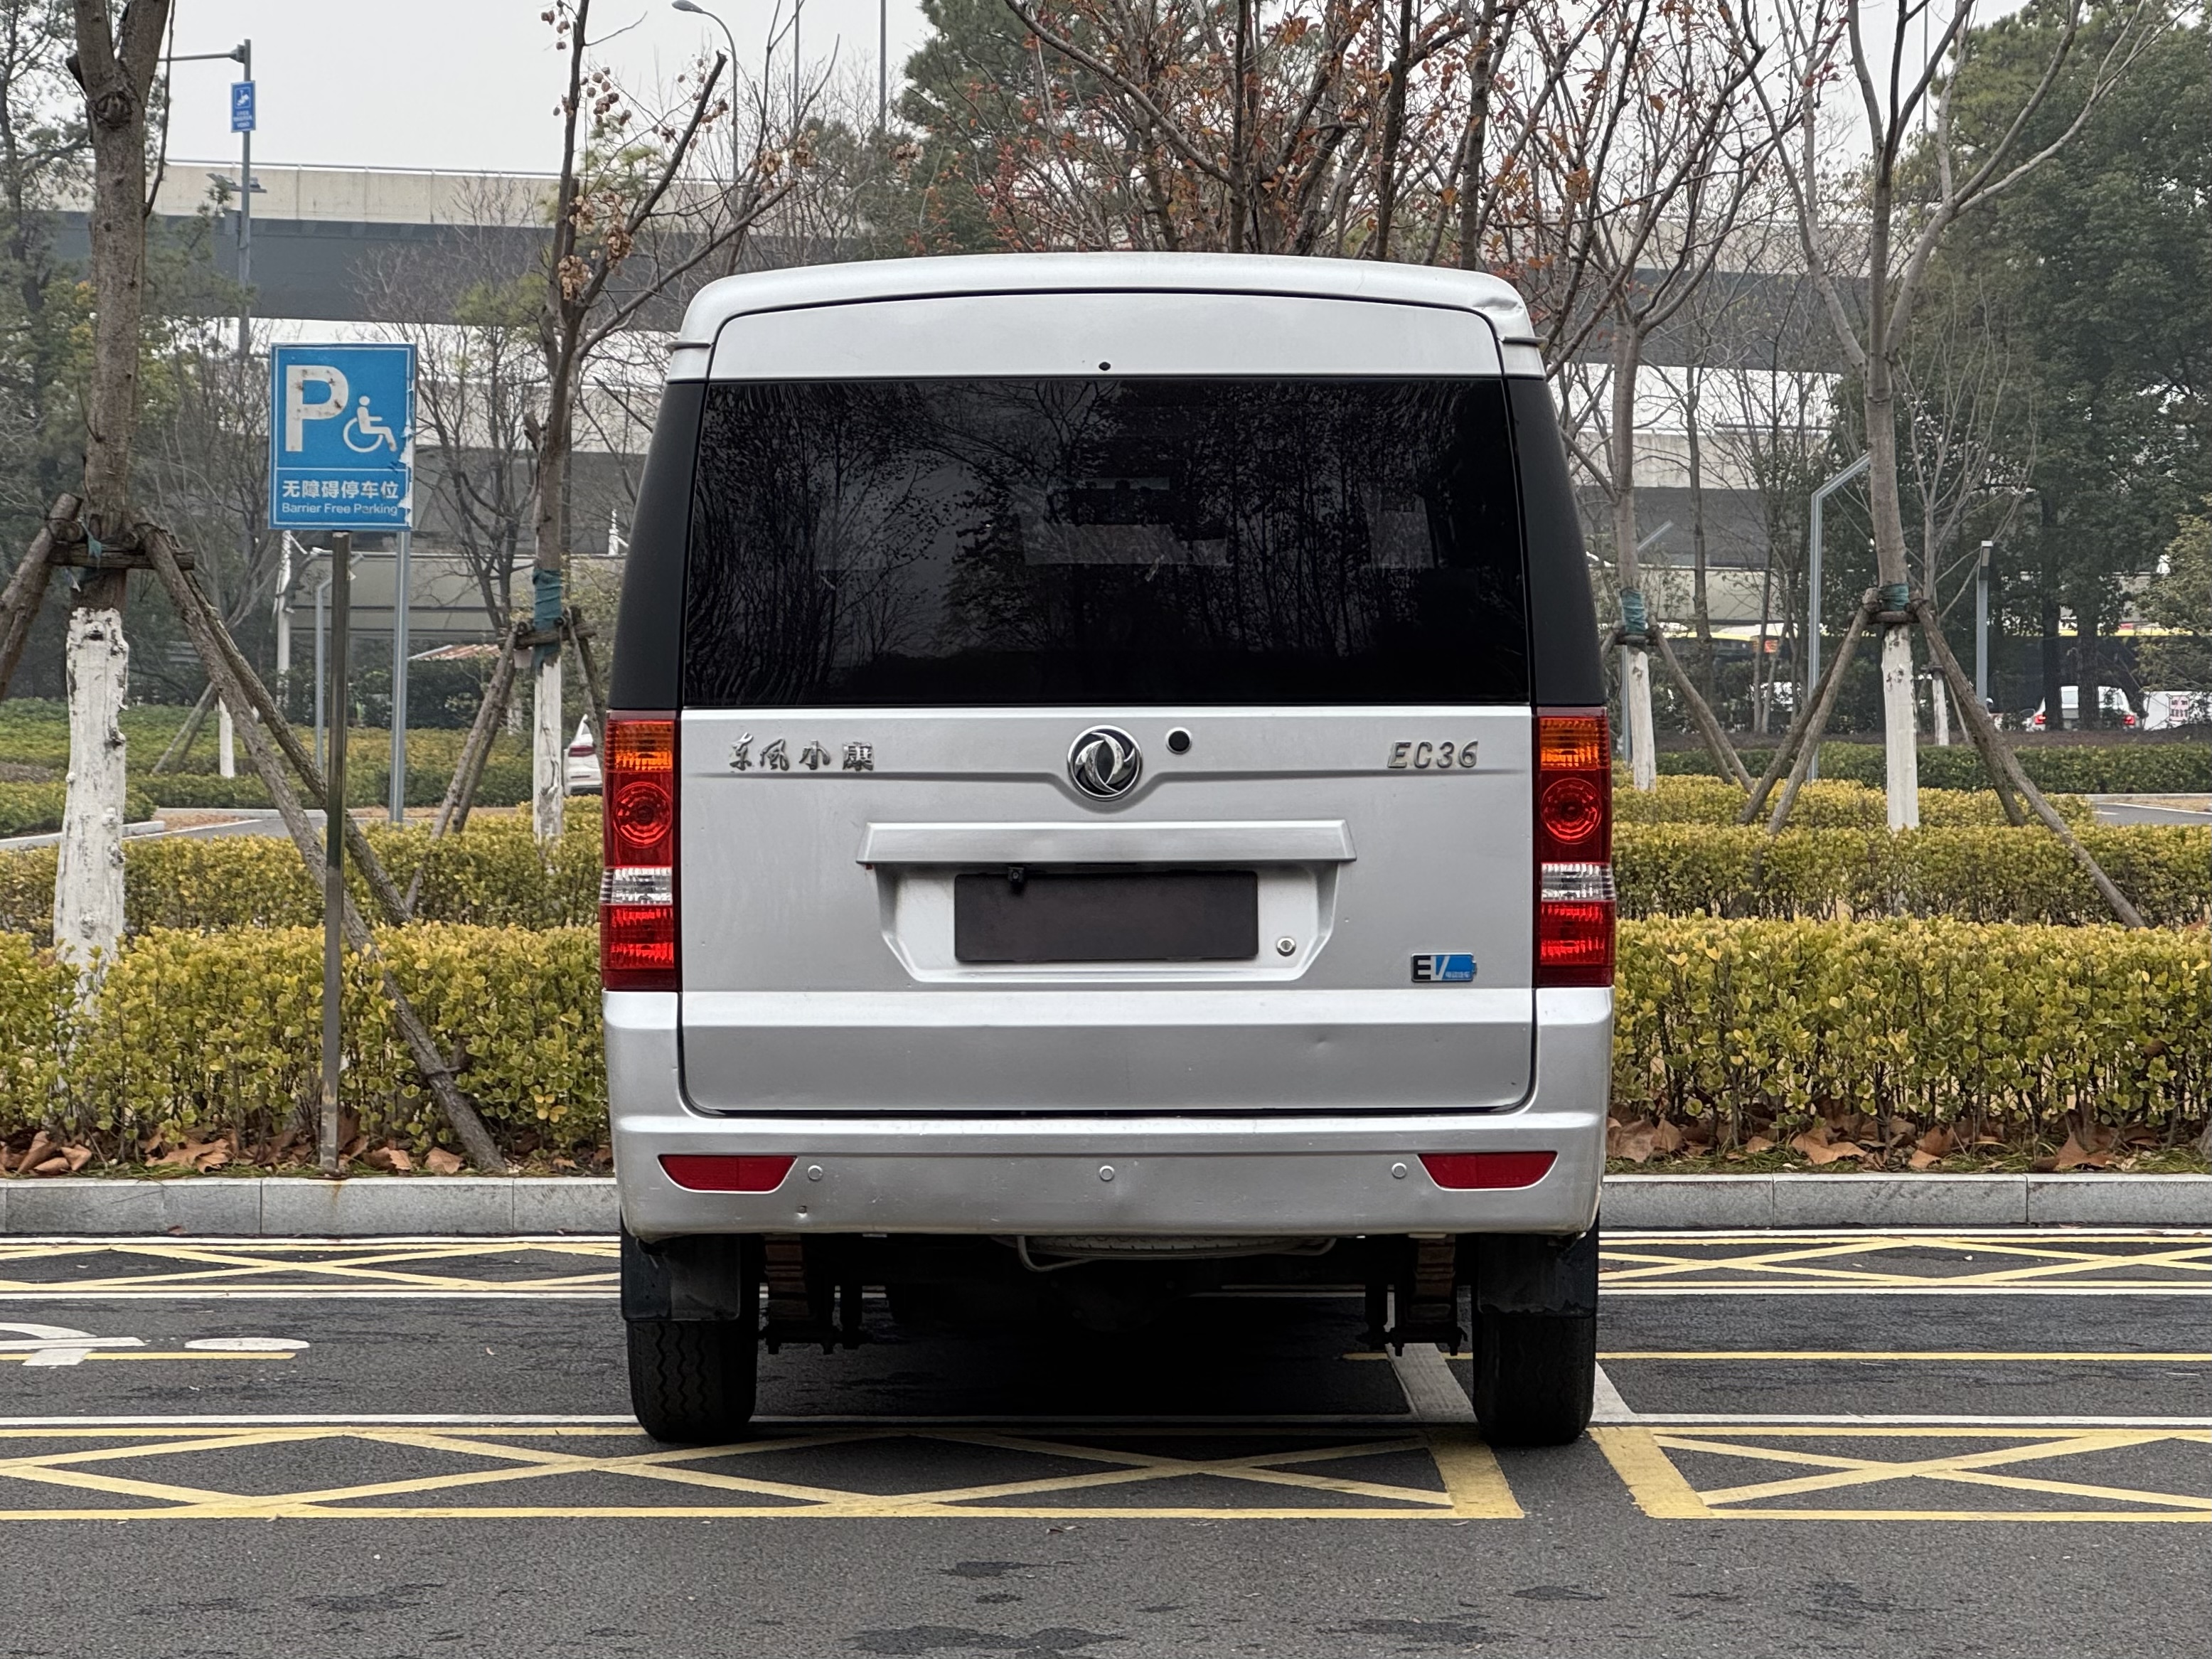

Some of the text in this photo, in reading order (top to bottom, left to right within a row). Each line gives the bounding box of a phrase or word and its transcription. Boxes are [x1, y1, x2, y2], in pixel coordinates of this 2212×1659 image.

[286, 365, 348, 452] P
[282, 480, 399, 499] 无障碍停车位
[282, 503, 398, 516] Barrier Free Parking
[730, 732, 874, 771] 东风小康
[1387, 740, 1479, 769] EC36
[1413, 955, 1450, 981] EV
